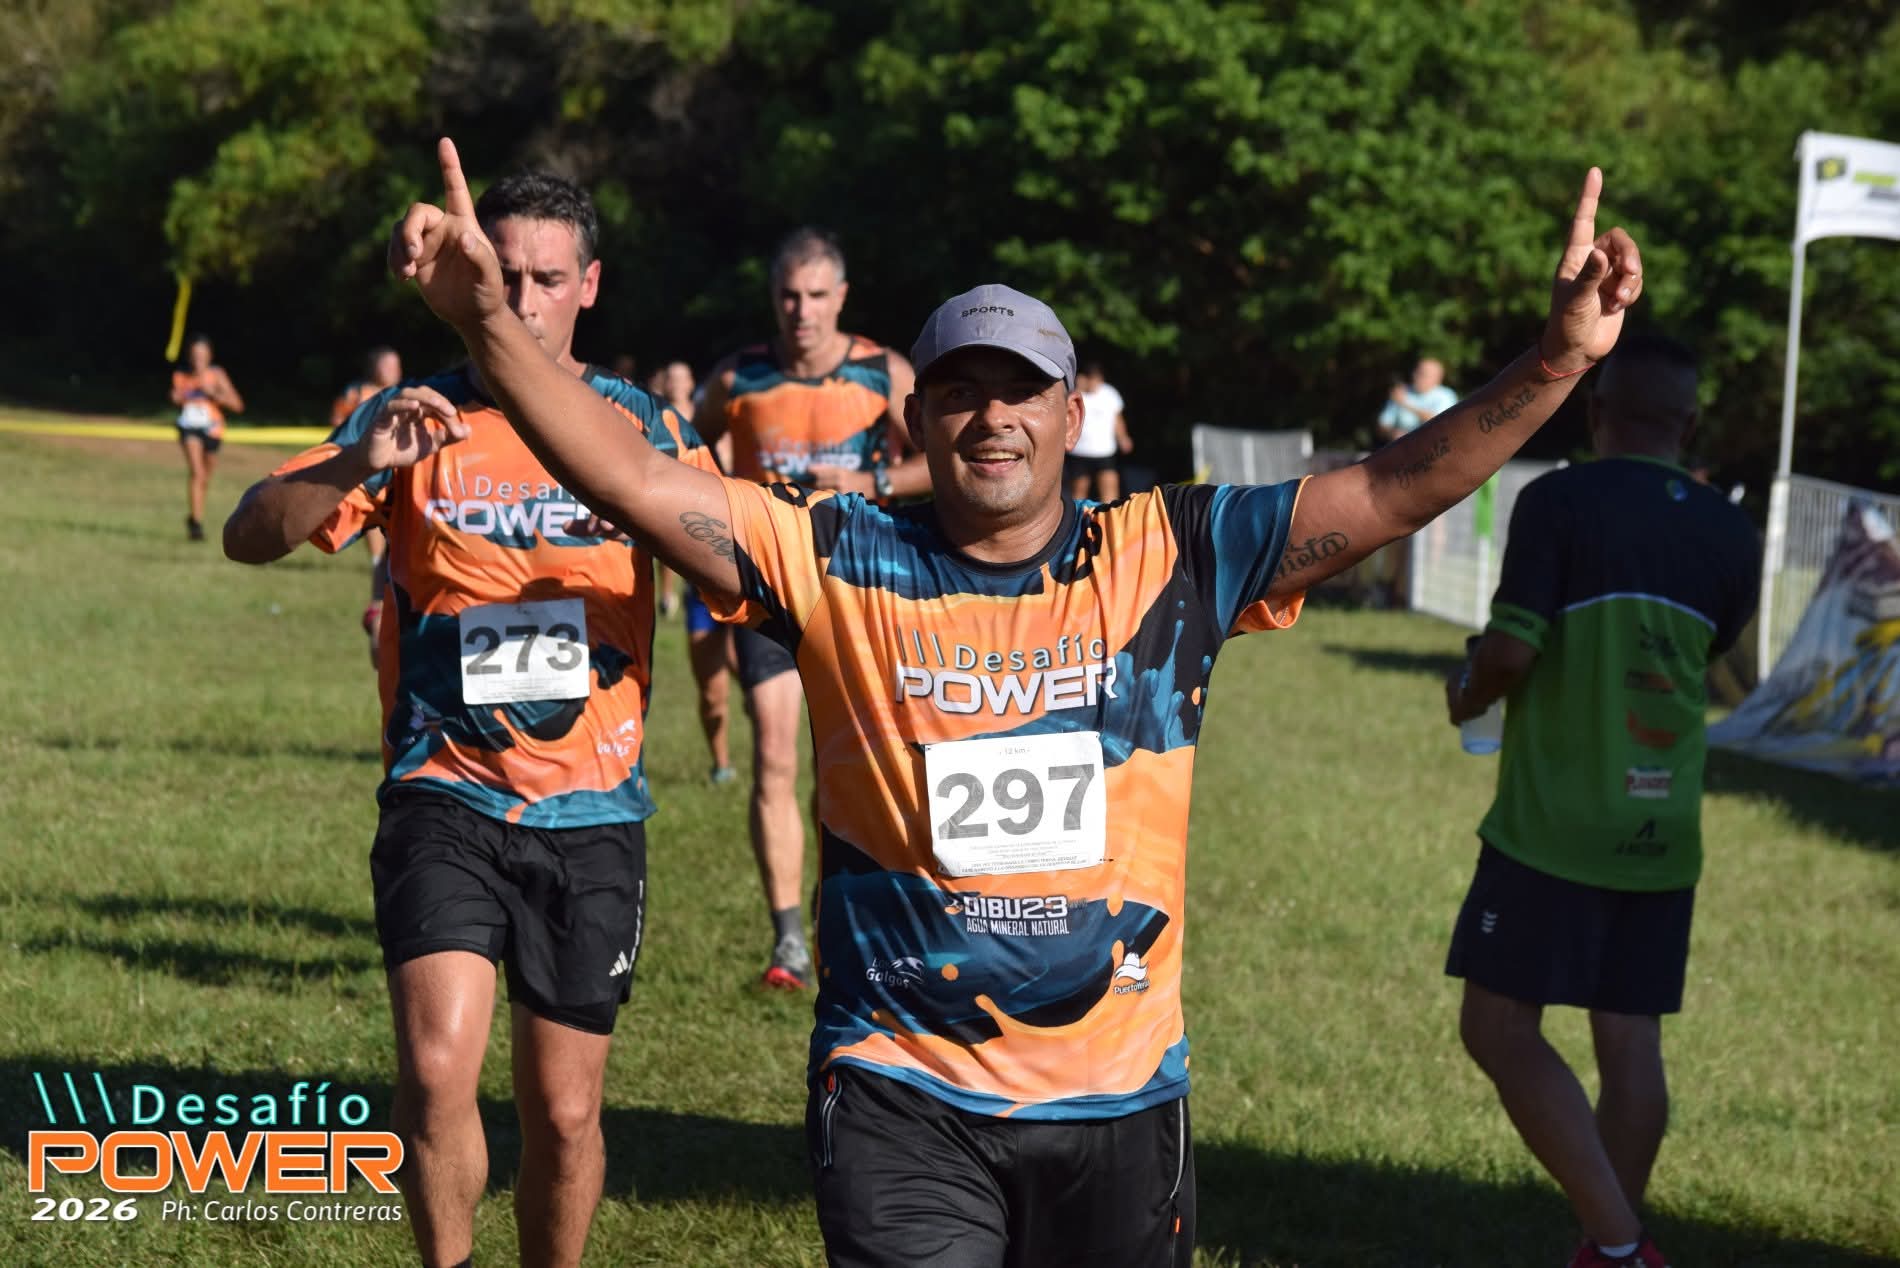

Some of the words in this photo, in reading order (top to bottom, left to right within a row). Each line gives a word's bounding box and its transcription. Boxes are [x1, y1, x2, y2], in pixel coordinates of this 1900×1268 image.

[960, 306, 1015, 318] SPORTS
[464, 623, 583, 676] 273
[955, 634, 1106, 673] Desafío
[896, 656, 1119, 715] POWER
[936, 763, 1095, 840] 297
[963, 895, 1068, 919] DIBU23
[967, 917, 988, 933] AGUA
[990, 919, 1029, 936] MINERAL
[1031, 918, 1070, 936] NATURAL
[866, 967, 909, 989] Galgos
